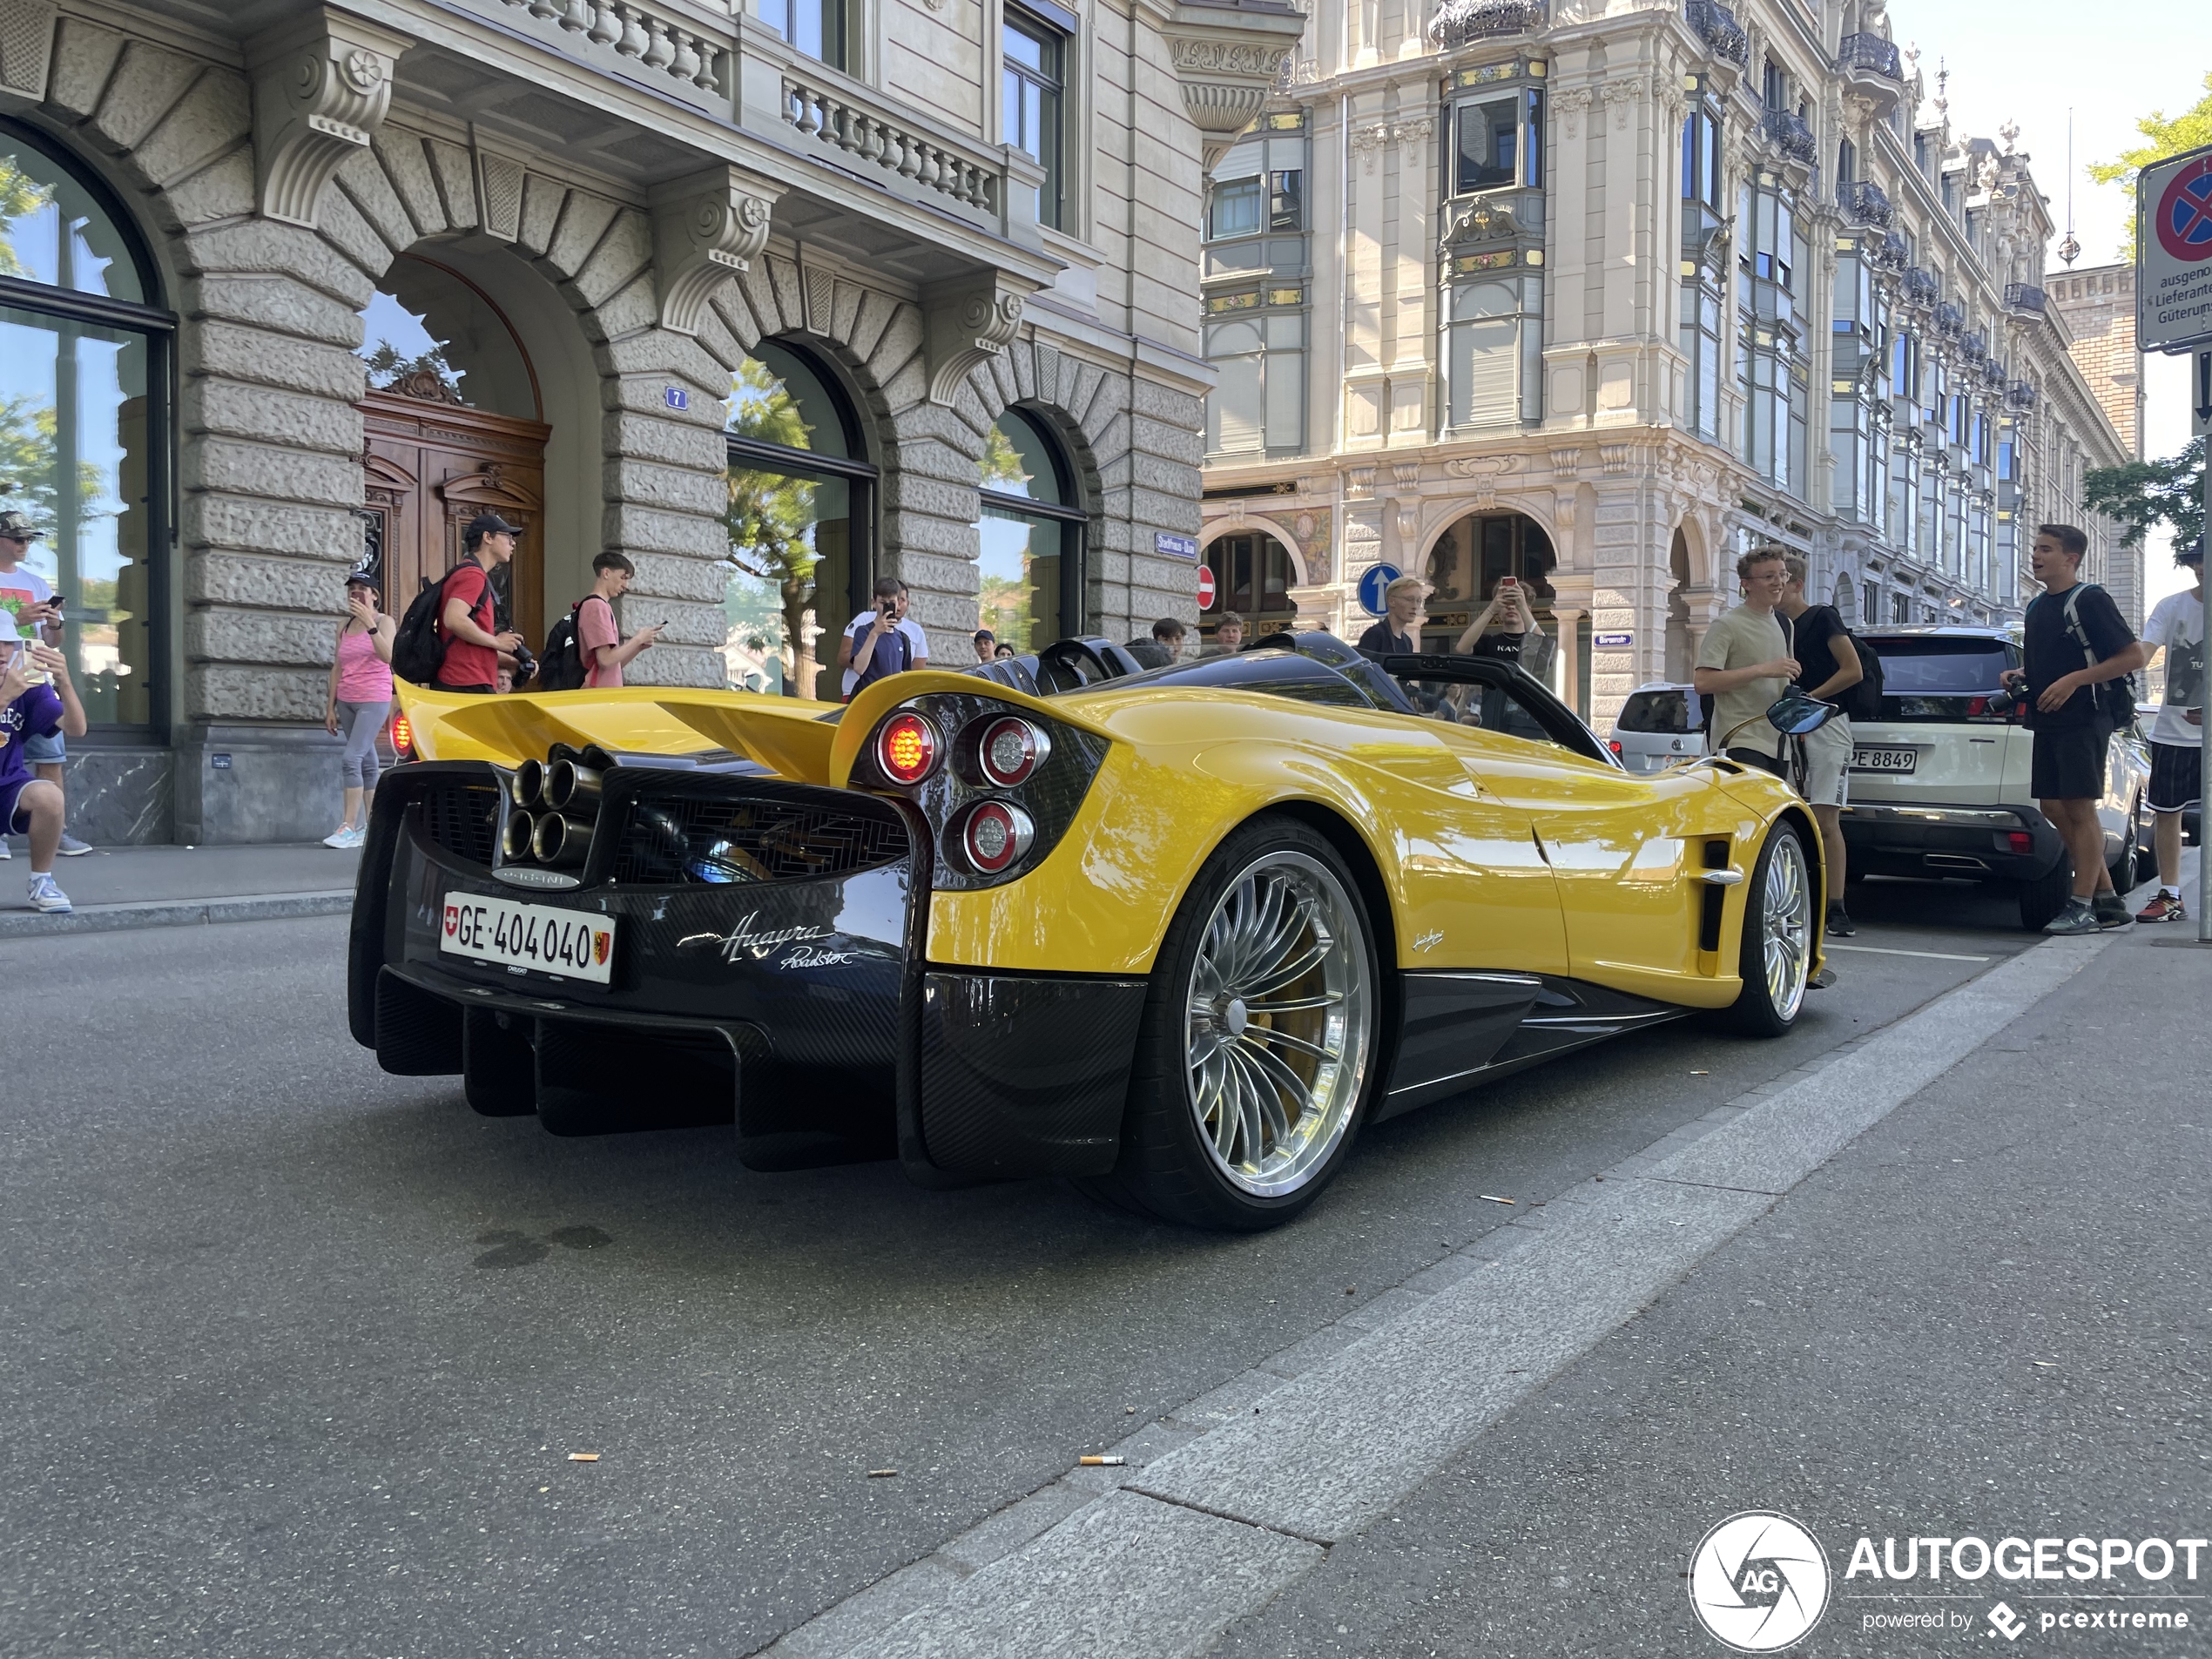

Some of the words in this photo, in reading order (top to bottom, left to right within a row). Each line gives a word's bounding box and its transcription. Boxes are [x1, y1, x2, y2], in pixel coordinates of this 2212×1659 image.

[2161, 266, 2212, 288] ausgeno
[2158, 302, 2212, 323] Güterum
[673, 391, 681, 406] 7
[1871, 752, 1913, 768] 8849
[715, 910, 836, 965] Huayra
[780, 946, 860, 970] Roadster
